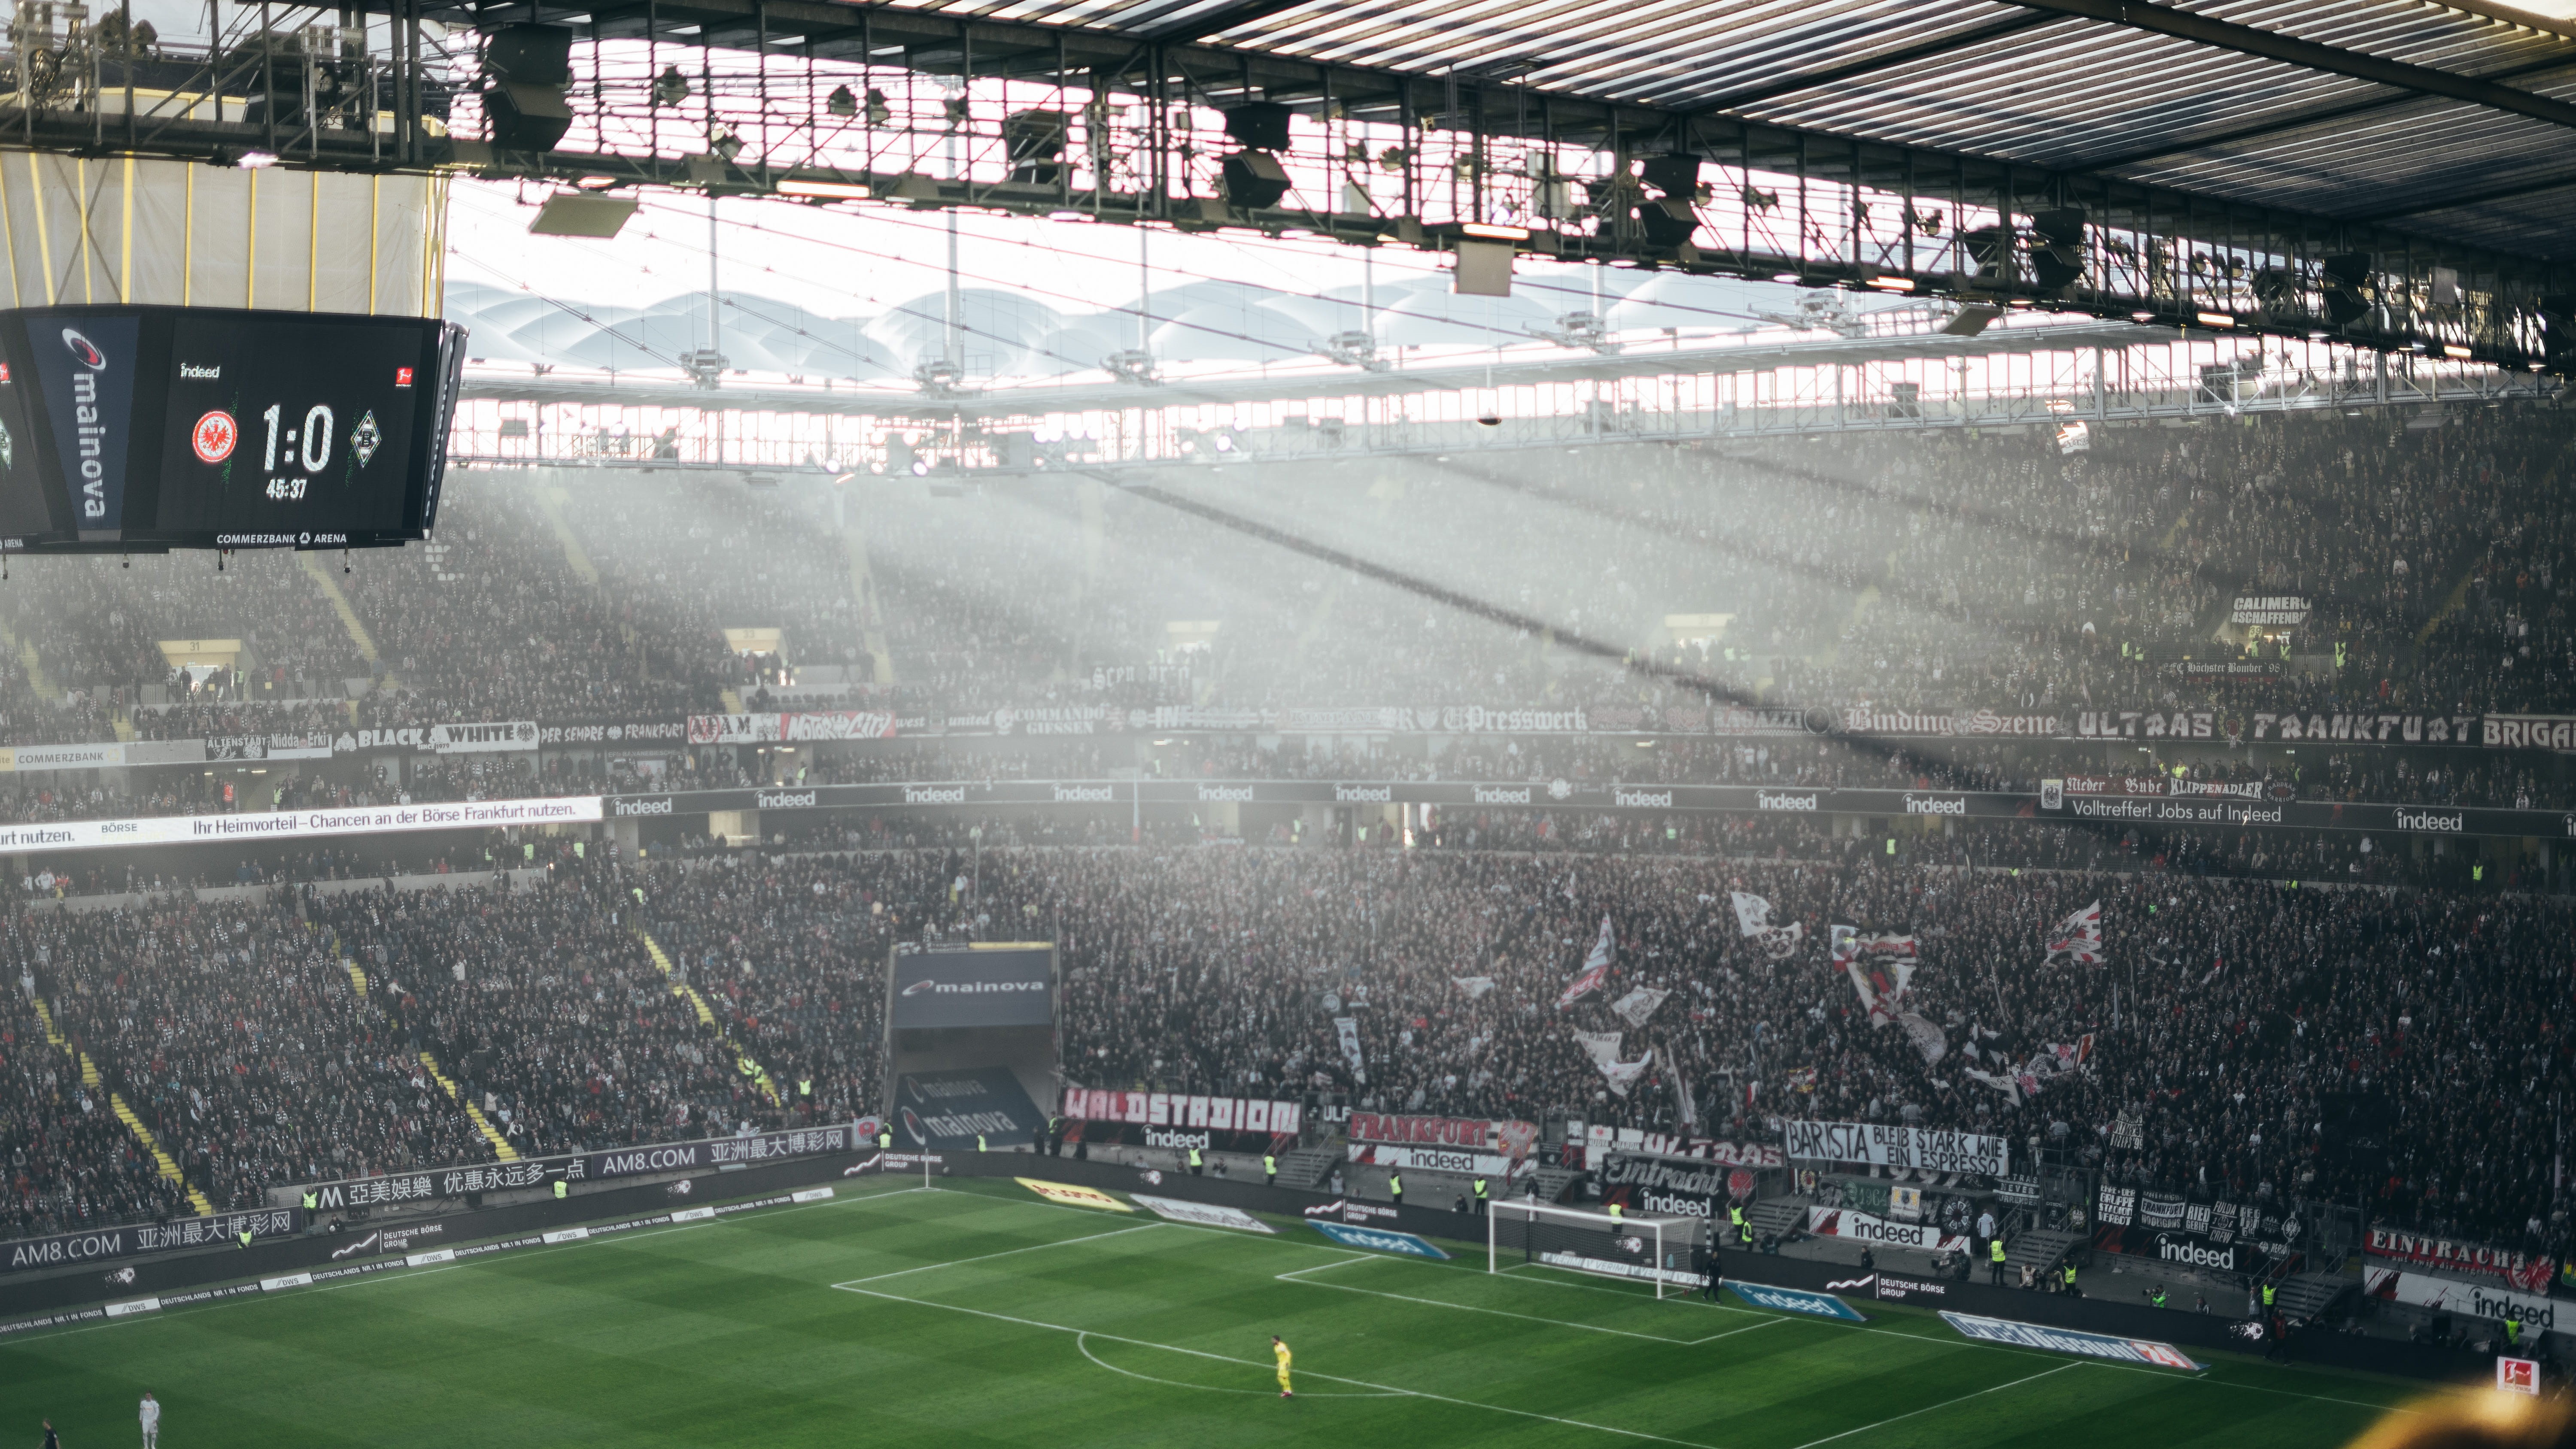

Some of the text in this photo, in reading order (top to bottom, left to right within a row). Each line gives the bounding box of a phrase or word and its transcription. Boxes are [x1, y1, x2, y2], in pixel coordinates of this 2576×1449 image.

[180, 362, 221, 379] indeed
[73, 373, 106, 517] mainova
[263, 403, 334, 473] 1:0
[266, 478, 307, 499] 45:37
[4, 538, 24, 549] ARENA
[216, 533, 347, 545] COMMERZBANK ARENA
[2233, 597, 2312, 610] CALIMERO
[2250, 626, 2263, 635] 39
[190, 642, 200, 651] 31
[2187, 662, 2263, 674] Höchster Bomber
[948, 711, 993, 727] united
[1014, 706, 1105, 721] COMMANDO
[1464, 704, 1588, 732] Presswerk
[1714, 711, 1803, 728] RAGAZZI
[1845, 708, 2057, 735] Binding Szene
[541, 725, 604, 744] PER SEMPRE
[625, 723, 685, 740] FRANKFURT
[1026, 721, 1094, 734] GIESSEN
[2078, 711, 2477, 742] ULTRAS FRANKFURT
[2483, 719, 2576, 750] BRIGA
[207, 737, 266, 748] ALTENSTADT
[271, 733, 299, 748] Nidda
[358, 724, 515, 747] BLACK WHITE
[18, 752, 104, 764] COMMERZBANK
[905, 786, 965, 803] indeed
[1054, 785, 1113, 801] indeed
[1197, 785, 1253, 801] indeed
[1335, 785, 1391, 801] indeed
[1474, 787, 1531, 803] indeed
[2169, 777, 2263, 800] KLIPPENADLER
[615, 798, 672, 815] indeed
[758, 791, 815, 807] indeed
[1615, 790, 1672, 807] indeed
[1759, 793, 1817, 810] indeed
[1906, 797, 1965, 814] indeed
[194, 803, 576, 836] Ihr Heimvorteil Chancen an der Börse Frankfurt nutzen.
[2072, 800, 2281, 823] Volltreffer! Jobs auf Indeed
[101, 822, 137, 834] BÖRSE
[2397, 811, 2463, 831] indeed
[21, 830, 75, 844] nutzen.
[936, 981, 1044, 993] mainova
[922, 1079, 987, 1098] mainova
[1064, 1087, 1301, 1133] WALDSTADION
[923, 1108, 1019, 1137] mainova
[1350, 1112, 1490, 1146] FRANKFURT
[1145, 1127, 1209, 1149] indeed
[1587, 1138, 1609, 1147] NUOVA
[1788, 1123, 2003, 1161] BARISTA BLEIB STARK WIE
[885, 1153, 919, 1162] DEUTSCHE
[1643, 1133, 1783, 1167] ULTRAS
[603, 1147, 696, 1175] AM8.COM
[1410, 1149, 1474, 1171] indeed
[1886, 1146, 1999, 1175] EIN ESPRESSO
[1606, 1153, 1722, 1196] Eintracht
[809, 1190, 823, 1199] DWS
[2000, 1182, 2035, 1195] NEVER
[2121, 1188, 2136, 1197] DER
[714, 1202, 755, 1215] DEUTSCHLANDS
[755, 1200, 767, 1208] NR.1
[774, 1196, 791, 1204] FONDS
[1643, 1191, 1710, 1217] indeed
[2100, 1192, 2135, 1208] GRUPPE
[2142, 1201, 2184, 1215] FRANKFURT
[2213, 1200, 2237, 1216] FULDA
[689, 1210, 704, 1219] DWS
[1347, 1203, 1397, 1217] DEUTSCHE BÖRSE
[1347, 1212, 1368, 1222] GROUP
[2099, 1202, 2133, 1216] STADION
[2187, 1205, 2211, 1223] RIED
[589, 1222, 631, 1235] DEUTSCHLANDS
[632, 1219, 644, 1228] NR.1
[652, 1216, 670, 1225] FONDS
[2098, 1211, 2132, 1226] VERBOT
[2141, 1214, 2181, 1228] HOOLIGANS
[2186, 1219, 2209, 1233] GEBIET
[383, 1224, 442, 1240] DEUTSCHE BÖRSE
[561, 1231, 577, 1240] DWS
[1853, 1216, 1924, 1246] indeed
[2209, 1229, 2233, 1244] CREW
[12, 1234, 120, 1267] AM8.COM
[383, 1238, 408, 1249] GROUP
[455, 1243, 500, 1257] DEUTSCHLANDS
[501, 1240, 513, 1249] NR.1
[522, 1237, 542, 1246] FONDS
[2371, 1228, 2526, 1271] EINTRACHT
[426, 1253, 442, 1262] DWS
[2162, 1235, 2234, 1270] indeed
[312, 1258, 404, 1280] DEUTSCHLANDS NR.1 IN FONDS
[2392, 1254, 2409, 1264] auf
[2412, 1258, 2435, 1269] ewig
[2439, 1261, 2456, 1271] dir
[281, 1276, 299, 1287] DWS
[1880, 1278, 1945, 1294] DEUTSCHE BÖRSE
[160, 1284, 258, 1306] DEUTSCHLANDS NR.1 IN FONDS
[1752, 1286, 1839, 1316] indeed
[1880, 1288, 1906, 1297] GROUP
[128, 1302, 146, 1313] DWS
[2473, 1290, 2555, 1330] indeed
[0, 1309, 103, 1332] DEUTSCHLANDS NR.1 IN FONDS
